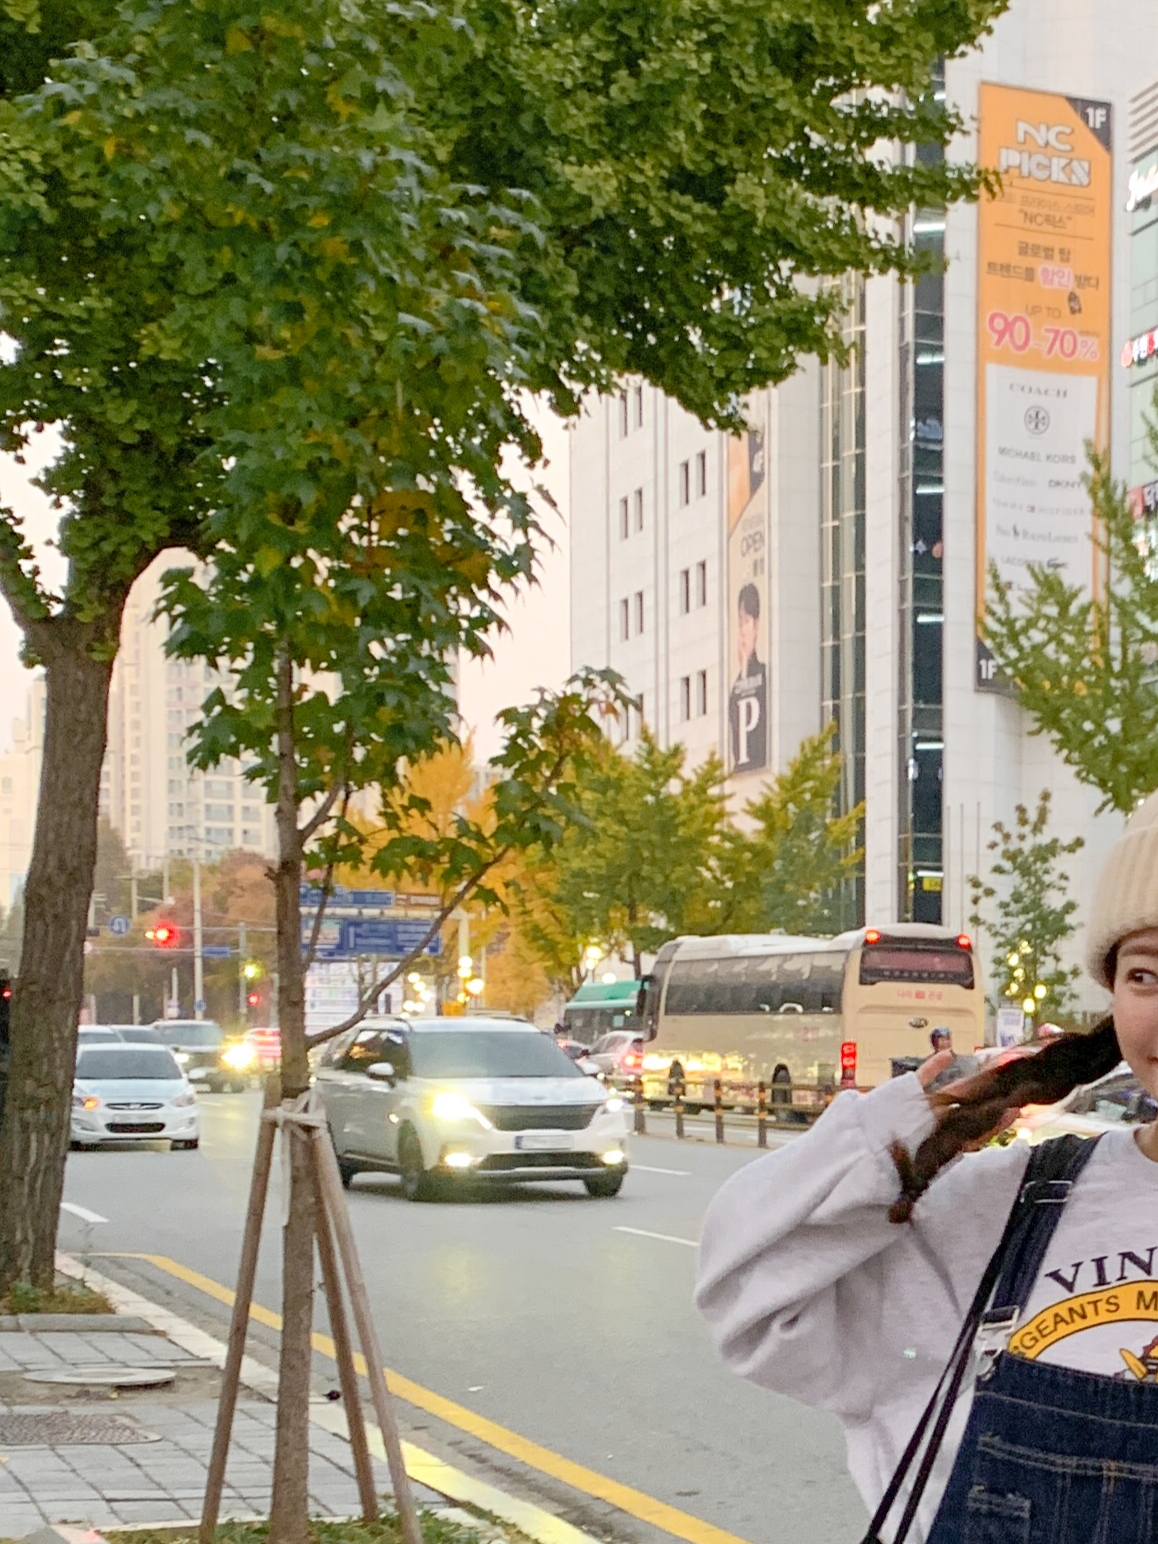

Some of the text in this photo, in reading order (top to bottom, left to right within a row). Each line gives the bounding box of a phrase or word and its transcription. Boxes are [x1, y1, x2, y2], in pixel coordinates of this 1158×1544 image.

[1085, 107, 1107, 129] 1F
[1016, 120, 1075, 152] NC
[999, 147, 1091, 188] PICKS
[1018, 241, 1055, 261] 글로벌
[1040, 266, 1071, 288] 할인
[1025, 304, 1062, 319] UP TO
[1009, 383, 1068, 398] COACH
[998, 446, 1078, 465] MICHAEL KORS
[979, 658, 998, 679] 1F
[737, 696, 760, 765] P
[1013, 1295, 1121, 1354] GEANTS
